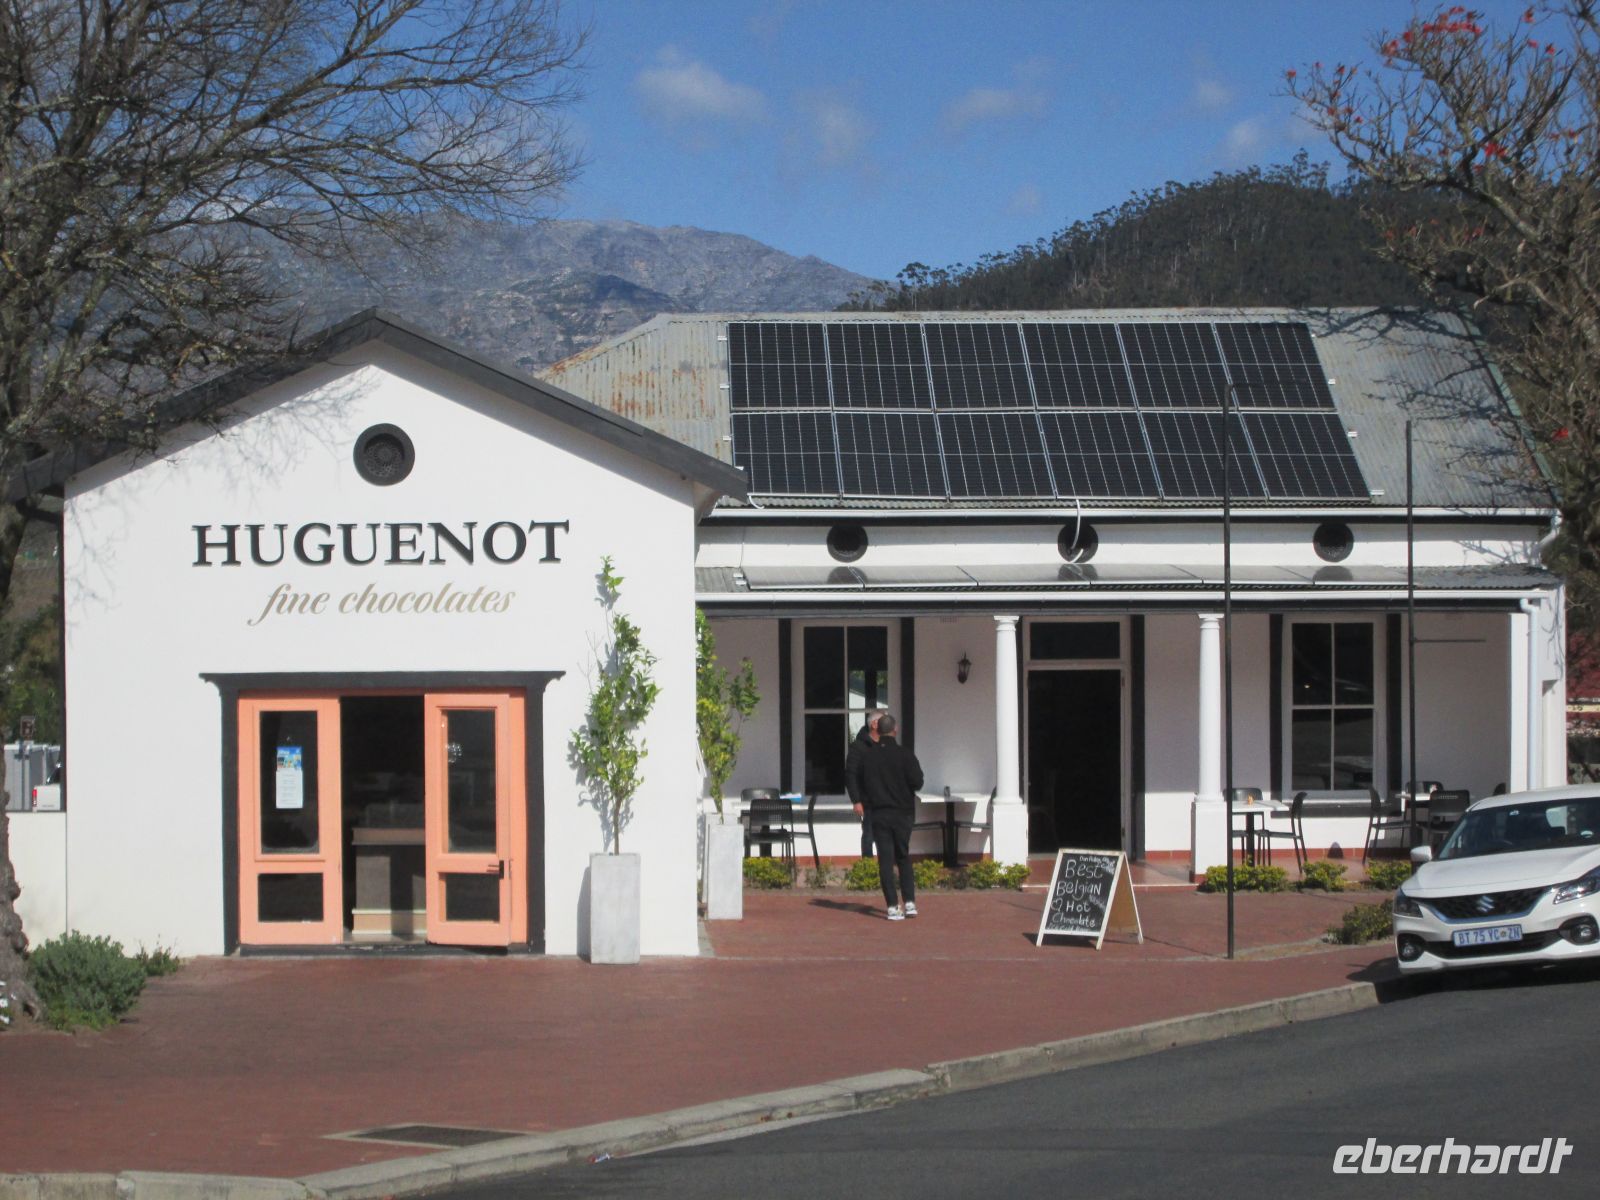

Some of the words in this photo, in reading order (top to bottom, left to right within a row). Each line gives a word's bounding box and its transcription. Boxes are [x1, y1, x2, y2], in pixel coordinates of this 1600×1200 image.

[191, 519, 570, 567] HUGUENOT
[247, 583, 331, 627] fine
[338, 581, 516, 616] chocolates
[1065, 859, 1103, 879] Best
[1066, 900, 1092, 913] Hot
[1458, 932, 1470, 944] BT
[1473, 930, 1485, 942] 75
[1488, 929, 1500, 941] YC
[1508, 927, 1520, 939] ZN
